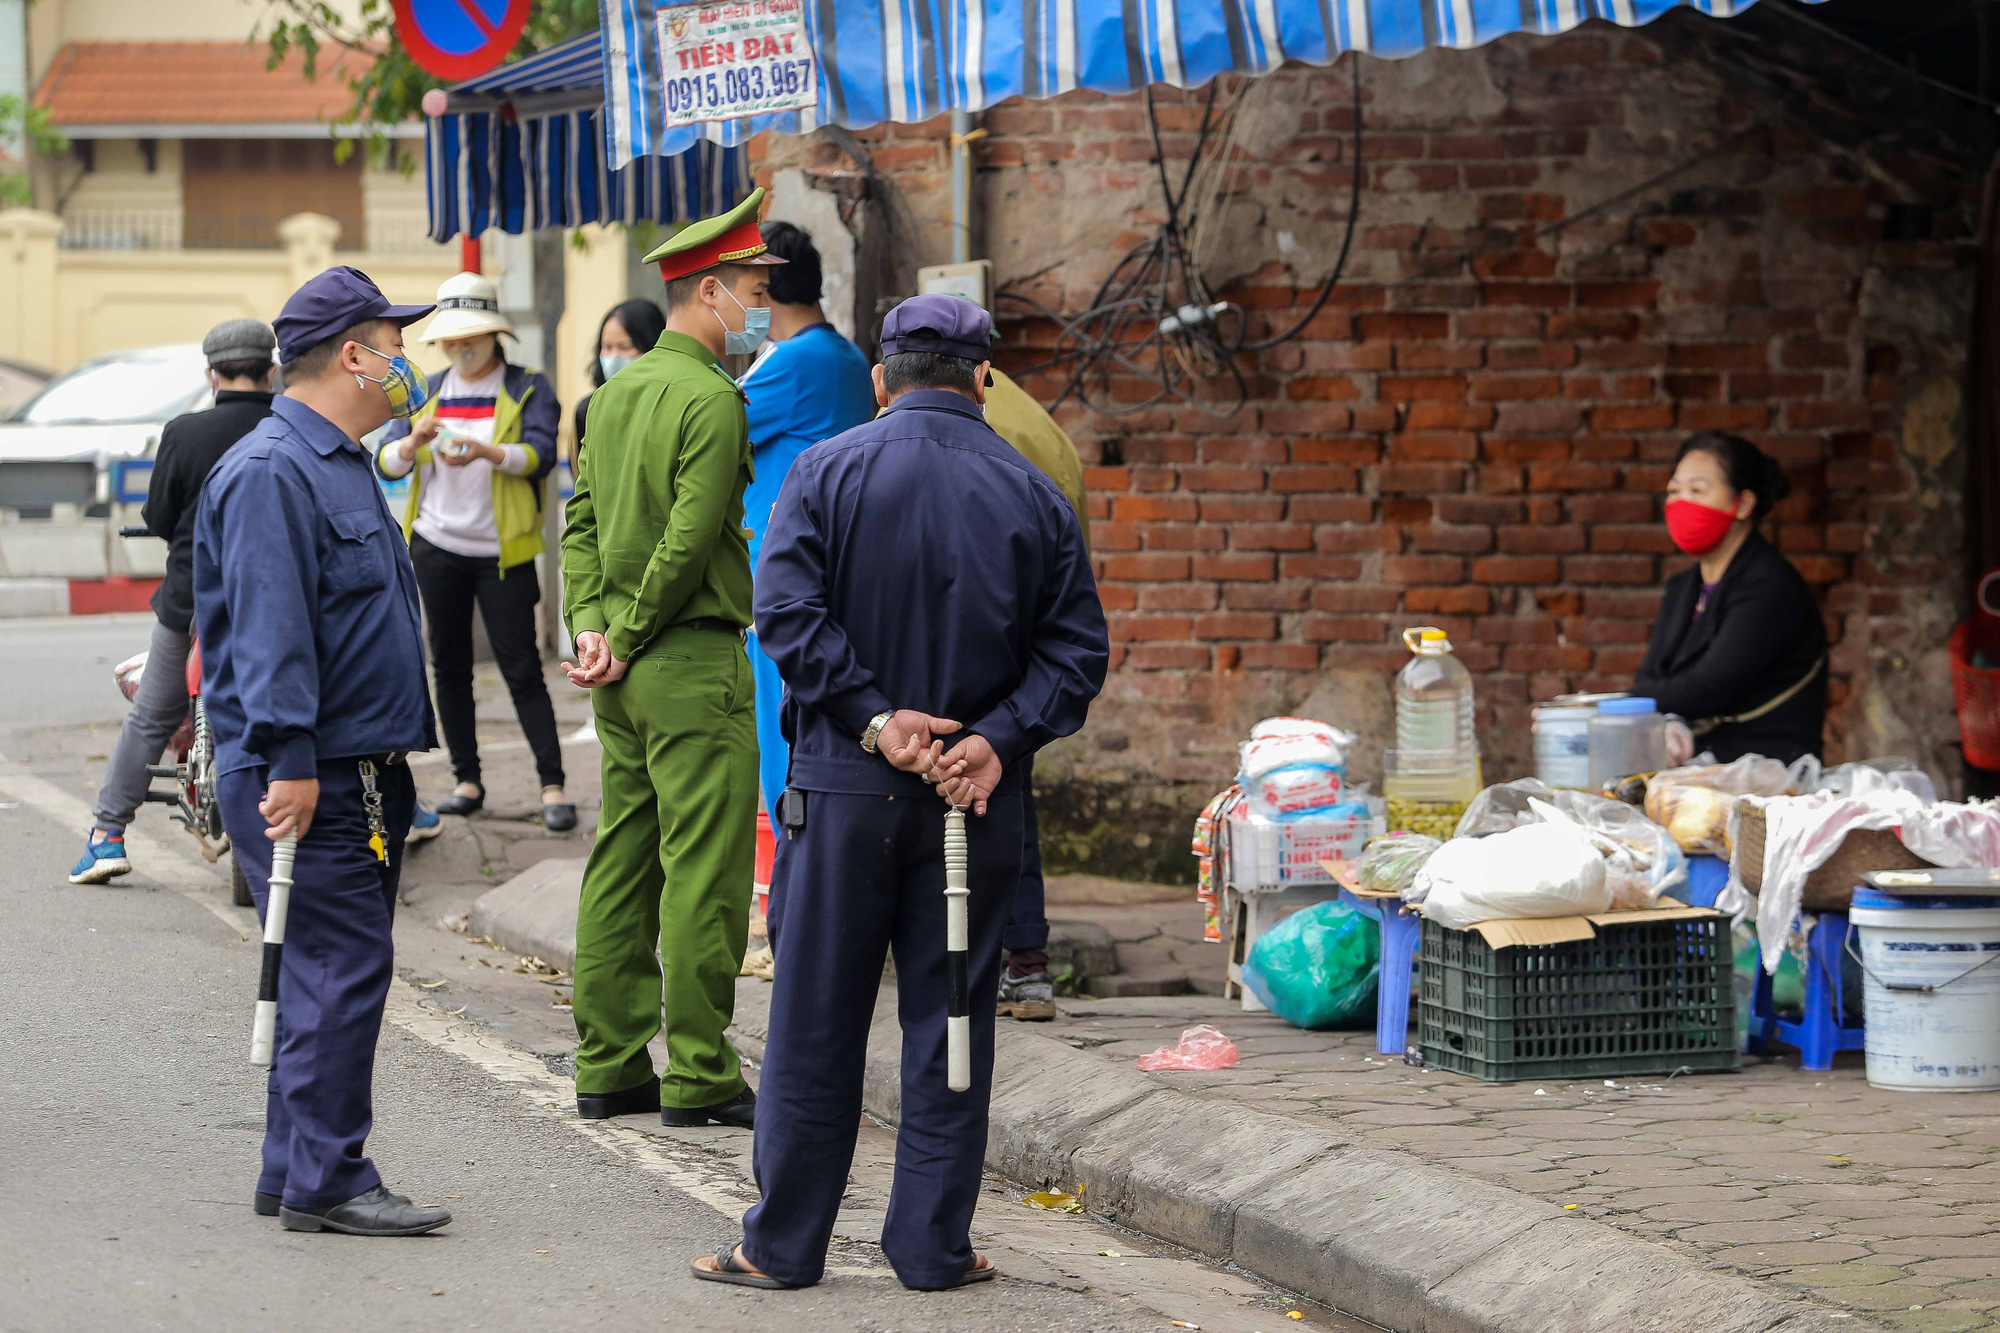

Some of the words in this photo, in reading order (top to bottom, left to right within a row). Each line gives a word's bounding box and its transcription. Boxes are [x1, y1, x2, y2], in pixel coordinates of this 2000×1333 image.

[675, 38, 735, 70] TIẾN
[744, 33, 795, 61] ĐẠT
[667, 59, 811, 113] 0915.083.967
